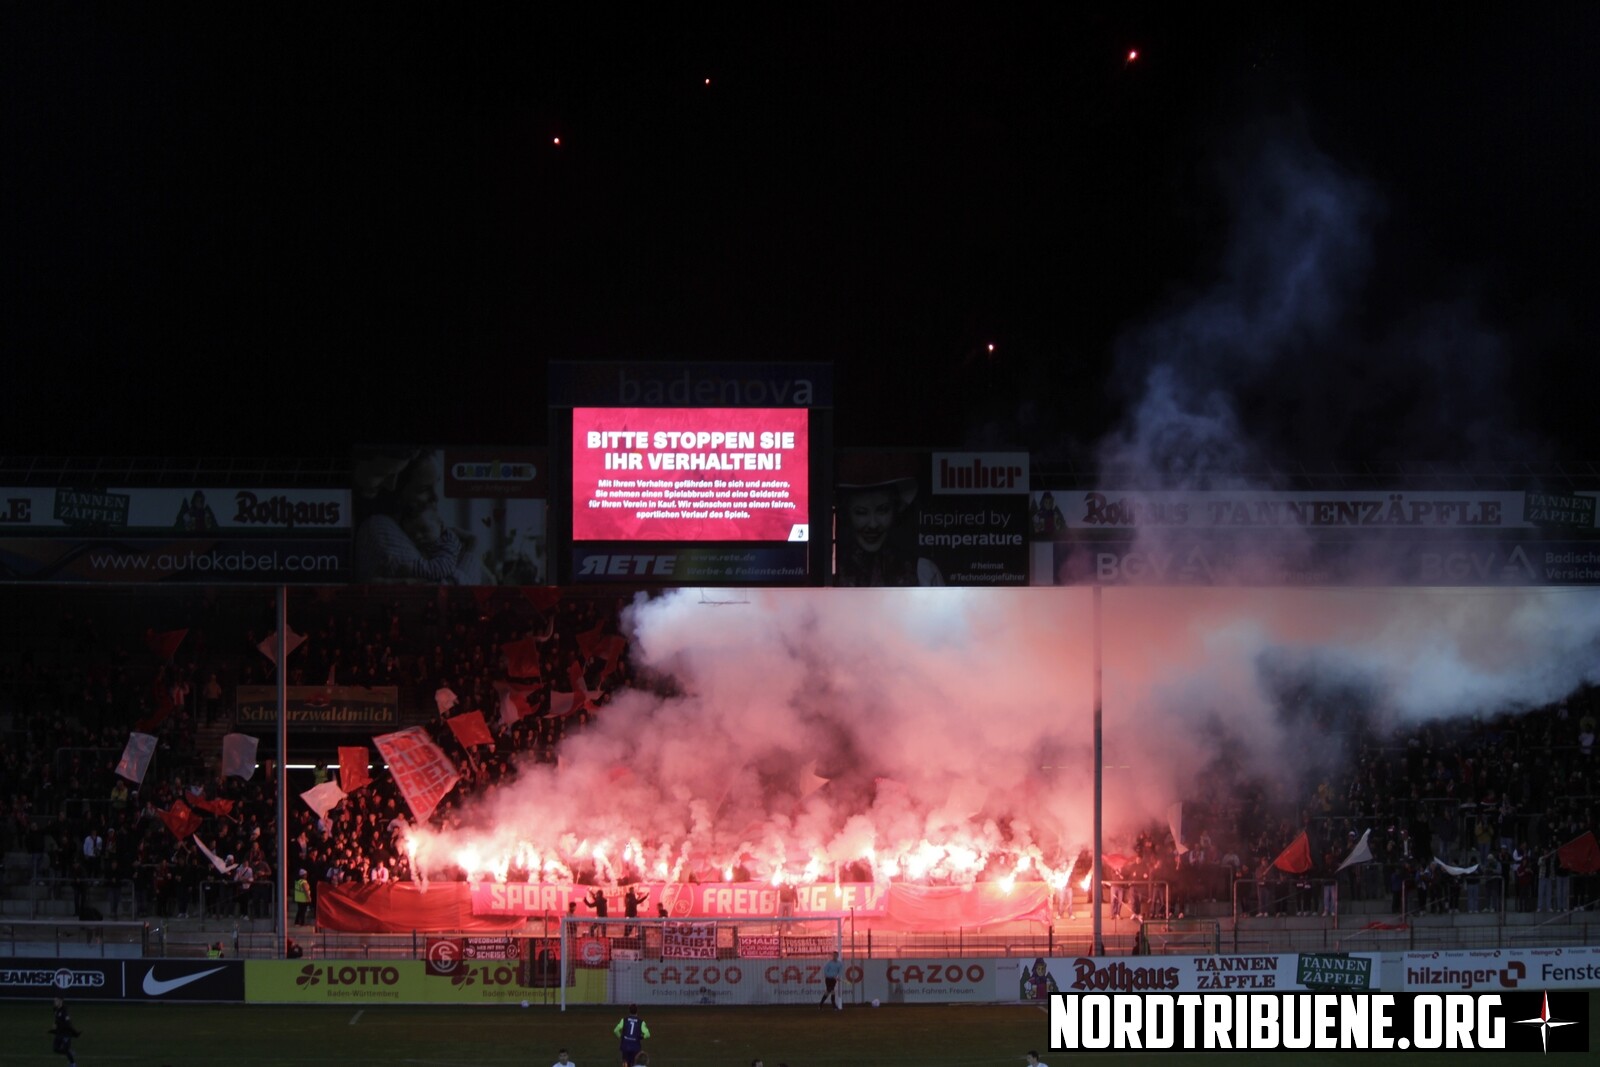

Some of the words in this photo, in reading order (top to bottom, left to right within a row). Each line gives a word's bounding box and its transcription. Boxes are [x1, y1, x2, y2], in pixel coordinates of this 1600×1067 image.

[619, 369, 813, 405] badenova
[587, 431, 649, 449] BITTE
[653, 431, 755, 449] STOPPEN
[759, 431, 795, 449] SIE
[604, 453, 643, 470] IHR
[647, 453, 782, 470] VERHALTEN!
[940, 458, 1022, 489] huber
[598, 479, 612, 487] Mit
[613, 479, 636, 487] Ihrem
[637, 479, 673, 487] Verhalten
[674, 479, 713, 489] gefährden
[714, 479, 727, 487] Sie
[728, 479, 745, 487] sich
[745, 479, 760, 487] und
[761, 479, 791, 488] andere.
[59, 491, 126, 509] TANNEN
[595, 489, 608, 498] Sie
[609, 489, 640, 498] nehmen
[641, 489, 663, 498] einen
[664, 489, 715, 499] Spielabbruch
[715, 489, 731, 498] und
[731, 489, 749, 498] eine
[750, 489, 790, 498] Geldstrafe
[1528, 494, 1593, 510] TANNEN
[233, 490, 340, 528] Rothaus
[588, 500, 601, 508] für
[601, 500, 622, 508] Ihren
[623, 500, 648, 508] Verein
[648, 500, 657, 508] in
[657, 500, 677, 508] Kauf.
[677, 500, 692, 508] Wir
[692, 500, 732, 509] wünschen
[732, 500, 748, 509] uns
[748, 500, 770, 509] einen
[1207, 494, 1502, 526] TANNENZÄPFLE
[59, 504, 123, 523] ZÄPFLE
[636, 511, 681, 519] sportlichen
[681, 511, 709, 519] Verlauf
[709, 511, 723, 519] des
[724, 511, 751, 520] Spiels.
[918, 510, 986, 527] Inspired
[990, 510, 1011, 527] by
[1529, 508, 1590, 525] ZÄPFLE
[918, 533, 1023, 548] temperature
[89, 550, 339, 572] www.autokabel.com
[690, 553, 756, 562] www.rete.de
[970, 561, 1004, 570] #heimat
[1422, 552, 1495, 580] BGV
[687, 567, 724, 576] Werbe-
[735, 566, 805, 576] Folientechnik
[1096, 553, 1172, 580] BGV
[950, 573, 1025, 584] #Technologieführer
[240, 706, 393, 721] Schwrzwaldmilch
[702, 886, 828, 914] FREIBRG
[664, 935, 715, 948] BLEIBT.
[664, 946, 715, 957] BASTA!
[1194, 956, 1279, 972] TANNEN
[1302, 955, 1369, 971] TANNEN
[327, 966, 399, 985] LOTTO
[643, 966, 742, 985] CAZOO
[764, 966, 864, 984] CAZO
[886, 965, 984, 983] CAZOO
[1071, 957, 1180, 992] Rothaus
[1197, 971, 1277, 989] ZÄPFLE
[1303, 969, 1366, 987] ZÄPFLE
[1407, 966, 1496, 989] hilzinger
[327, 990, 399, 998] Baden-Württemberg
